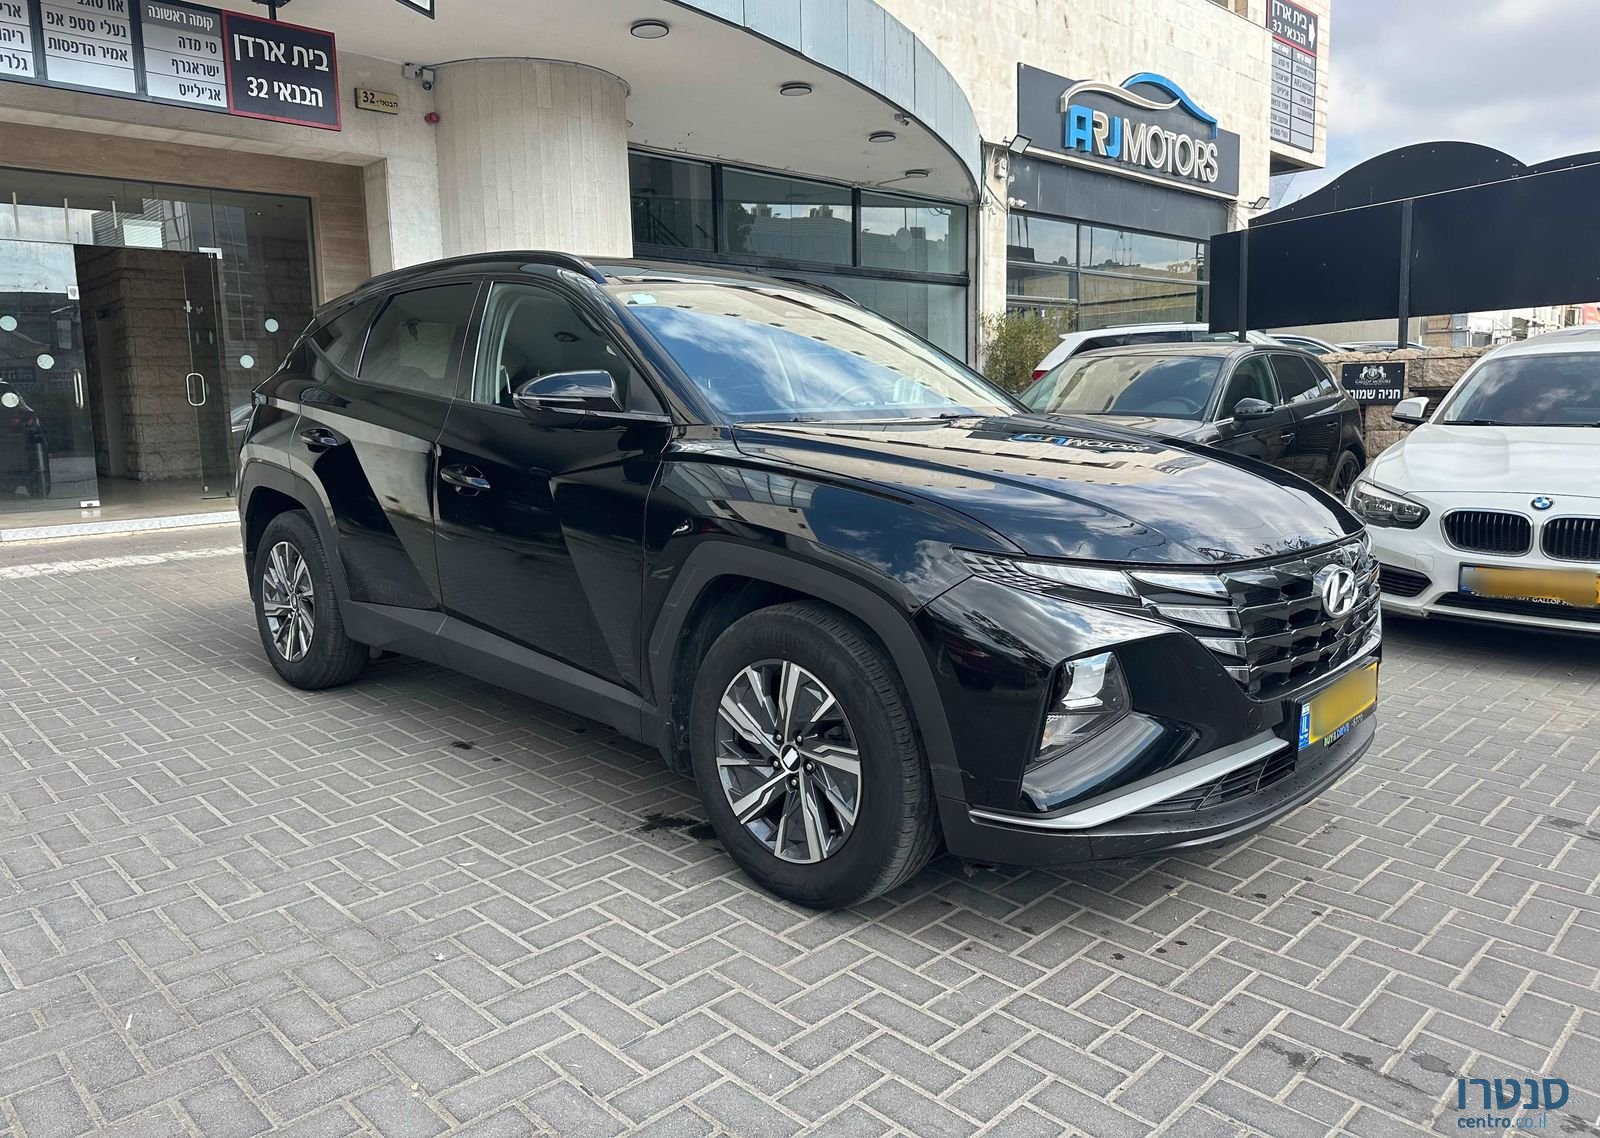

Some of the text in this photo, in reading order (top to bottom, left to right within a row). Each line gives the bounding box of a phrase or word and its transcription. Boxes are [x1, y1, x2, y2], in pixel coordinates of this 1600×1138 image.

[46, 11, 127, 38] נעלי סטפ אפ
[147, 5, 213, 31] קומה ראשונה
[1272, 19, 1282, 34] 32
[1292, 10, 1307, 30] בית
[48, 36, 128, 62] אמיר הדפסות
[178, 36, 217, 54] סי מדה
[233, 33, 329, 72] בית ארדן
[171, 58, 219, 77] ישראגרף
[246, 76, 324, 108] הבנאי 32
[1064, 104, 1219, 183] ARJ MOTORS
[1378, 389, 1400, 399] חניה
